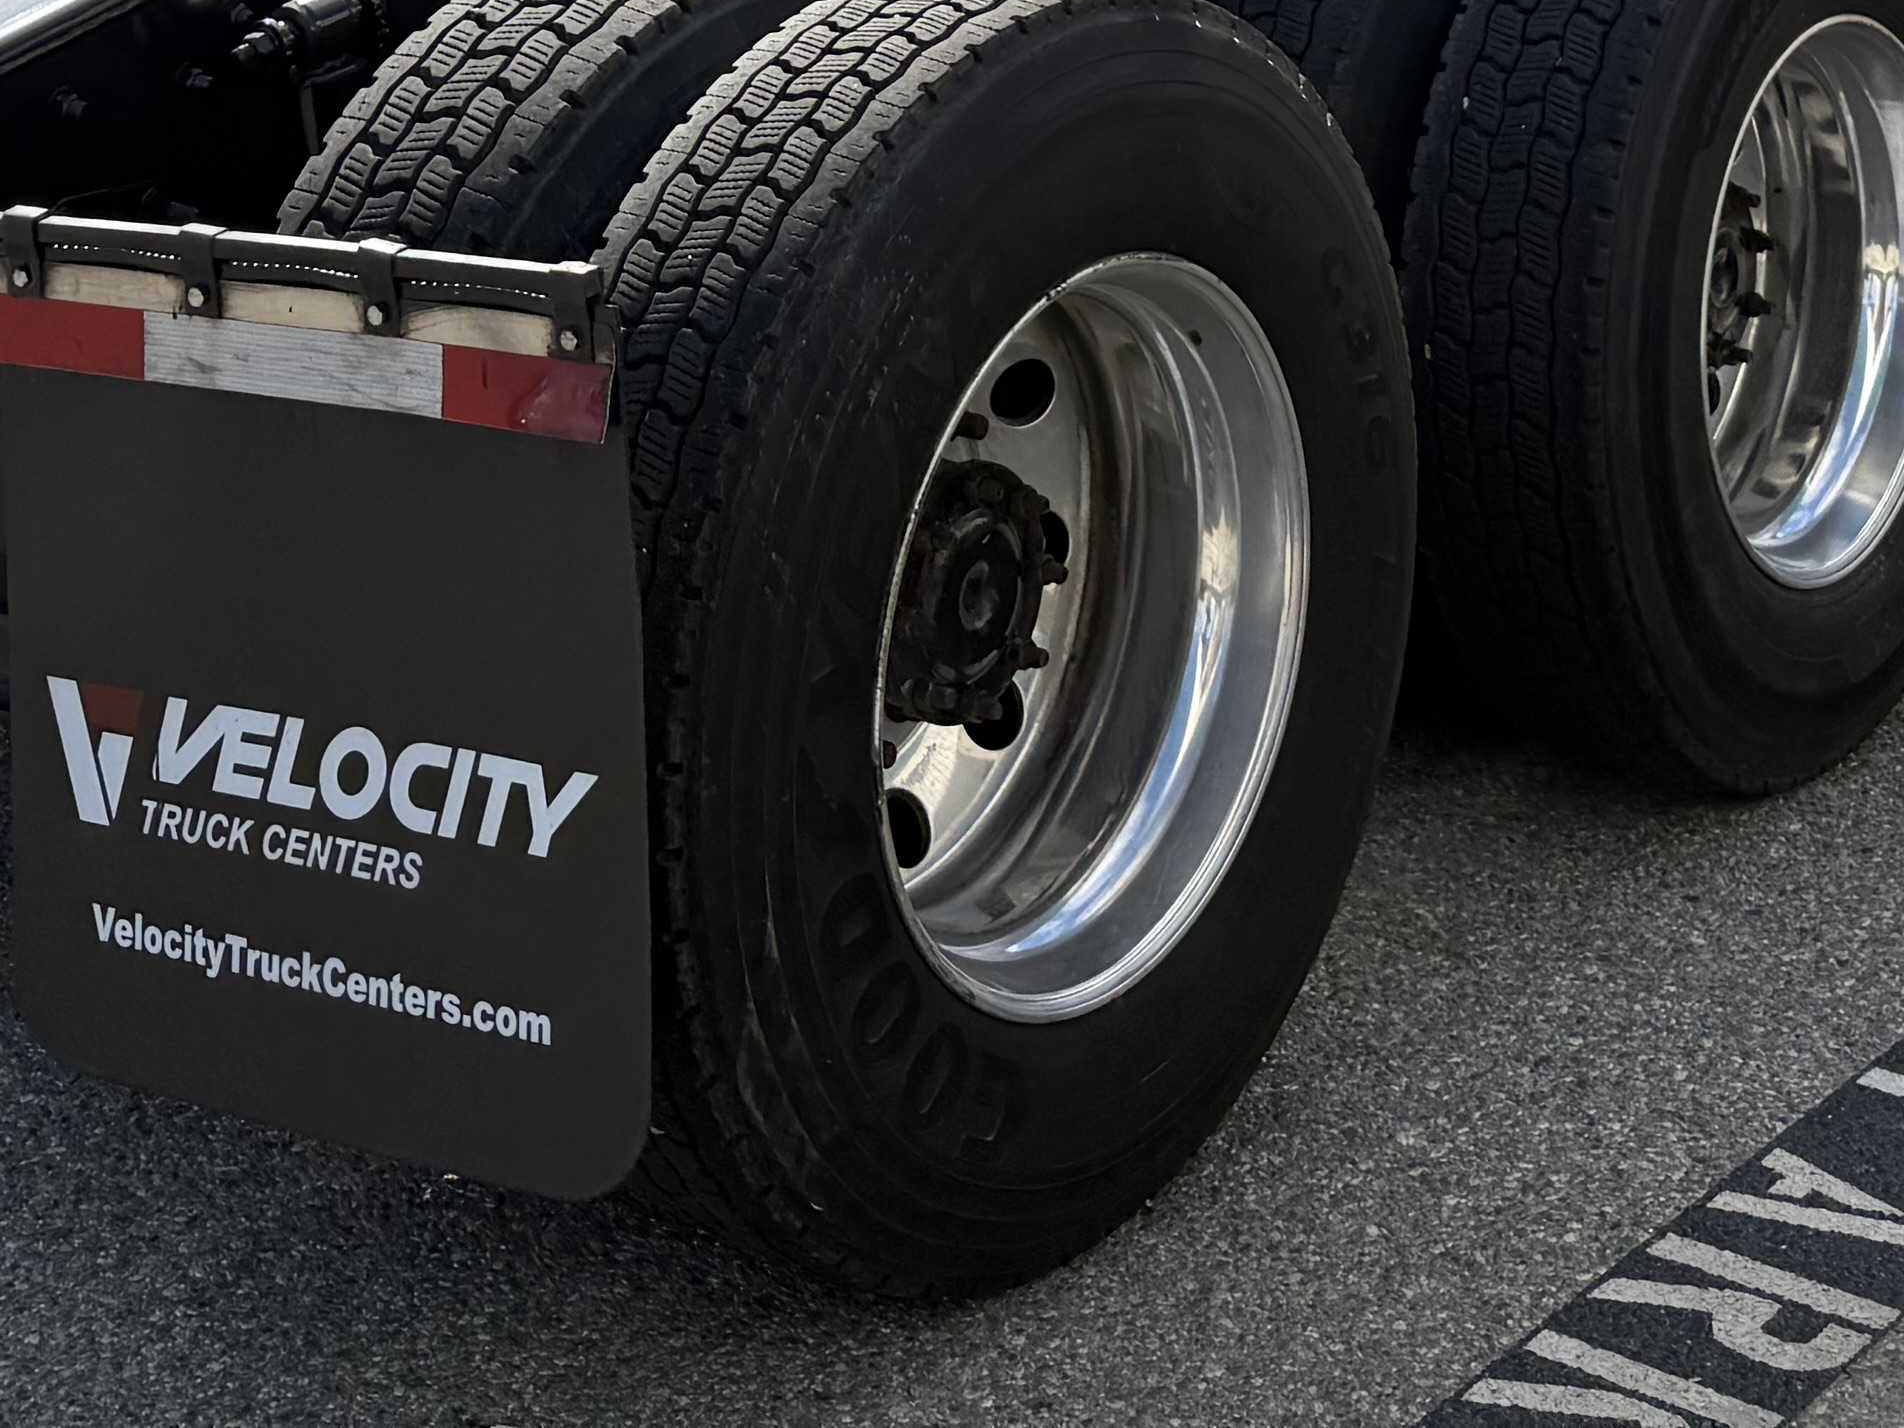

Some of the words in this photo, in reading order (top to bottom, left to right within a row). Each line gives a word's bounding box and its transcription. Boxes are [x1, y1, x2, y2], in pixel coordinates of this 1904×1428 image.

[141, 799, 255, 854] TRUCK
[262, 823, 424, 890] CENTERS
[153, 695, 599, 858] VELOCITY
[92, 902, 552, 1047] VelocityTruckCenters.com
